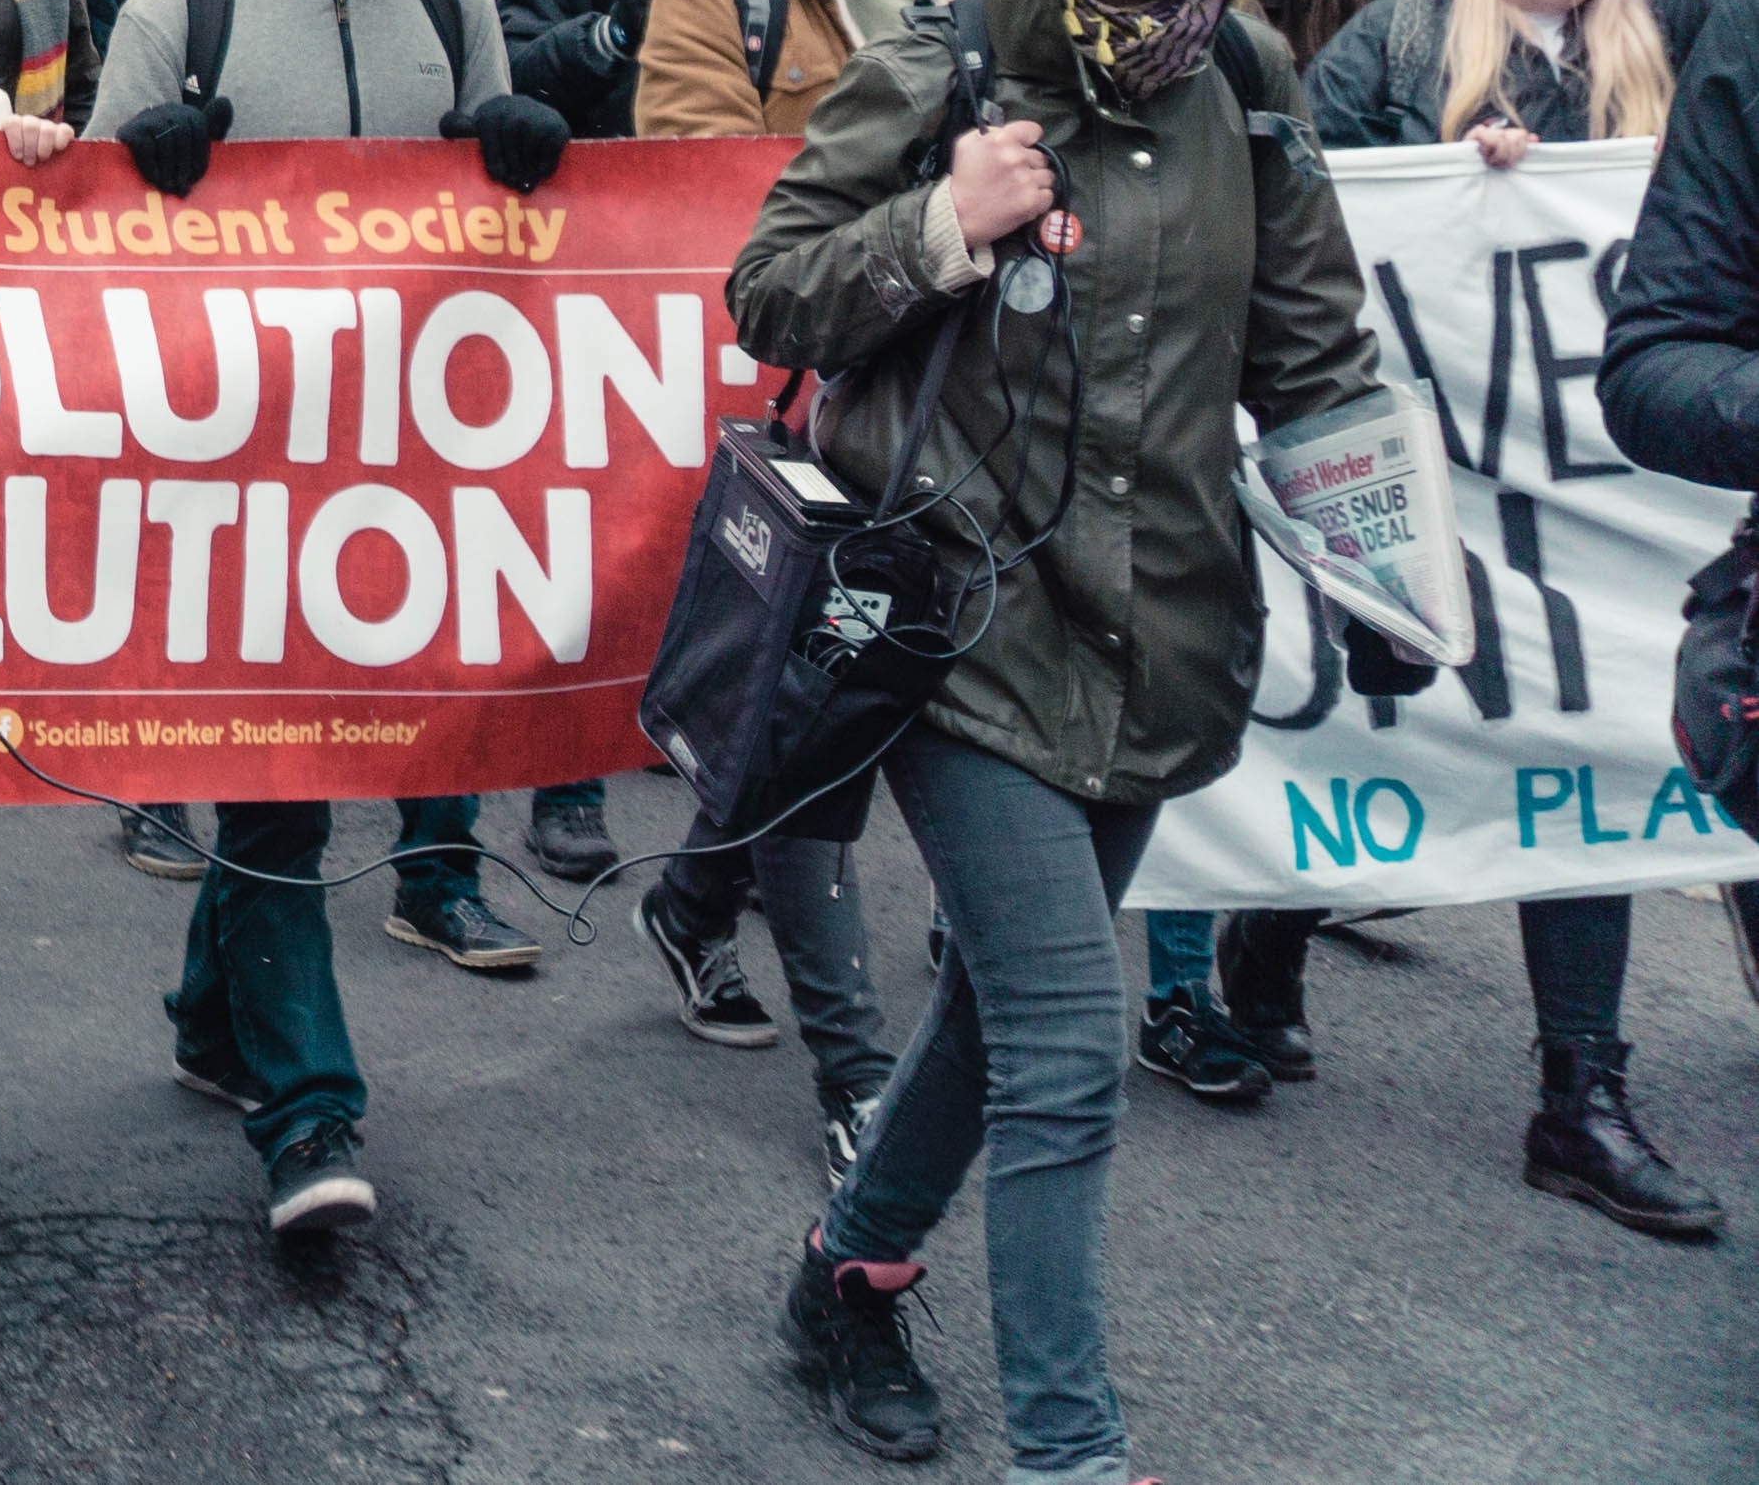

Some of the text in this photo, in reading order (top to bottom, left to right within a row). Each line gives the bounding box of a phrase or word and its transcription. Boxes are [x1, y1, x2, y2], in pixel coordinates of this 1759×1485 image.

[3, 187, 294, 256] Student
[321, 190, 567, 263] Society
[1315, 452, 1375, 490] Worker
[1350, 483, 1408, 524] SNUB
[1362, 515, 1416, 553] DEAL
[136, 720, 225, 746] Worker
[231, 718, 323, 745] Student
[1284, 777, 1426, 871] NO
